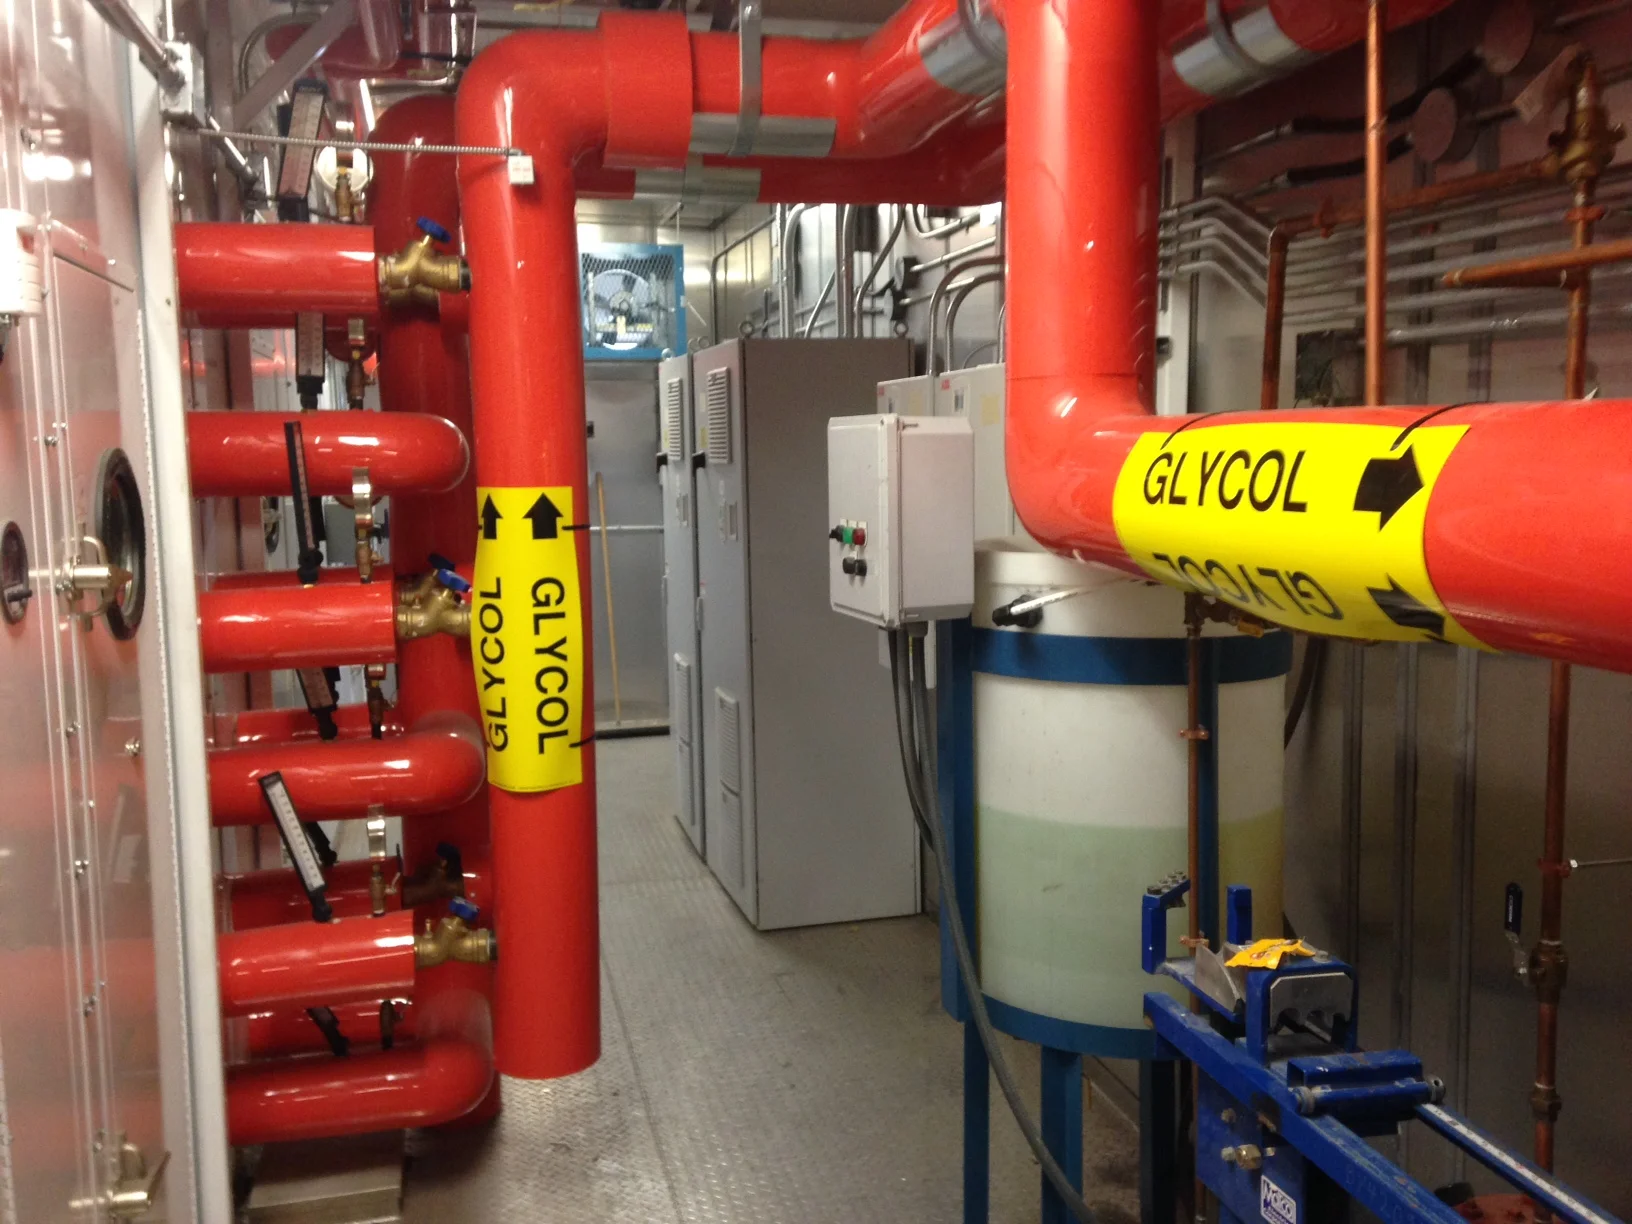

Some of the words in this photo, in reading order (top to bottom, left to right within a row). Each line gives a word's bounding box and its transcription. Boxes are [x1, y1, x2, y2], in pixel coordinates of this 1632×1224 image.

[1143, 450, 1308, 513] GLYCOL
[1151, 551, 1344, 621] GLYCOL
[480, 577, 508, 753] GLYCOL
[531, 576, 569, 755] GLYCOL
